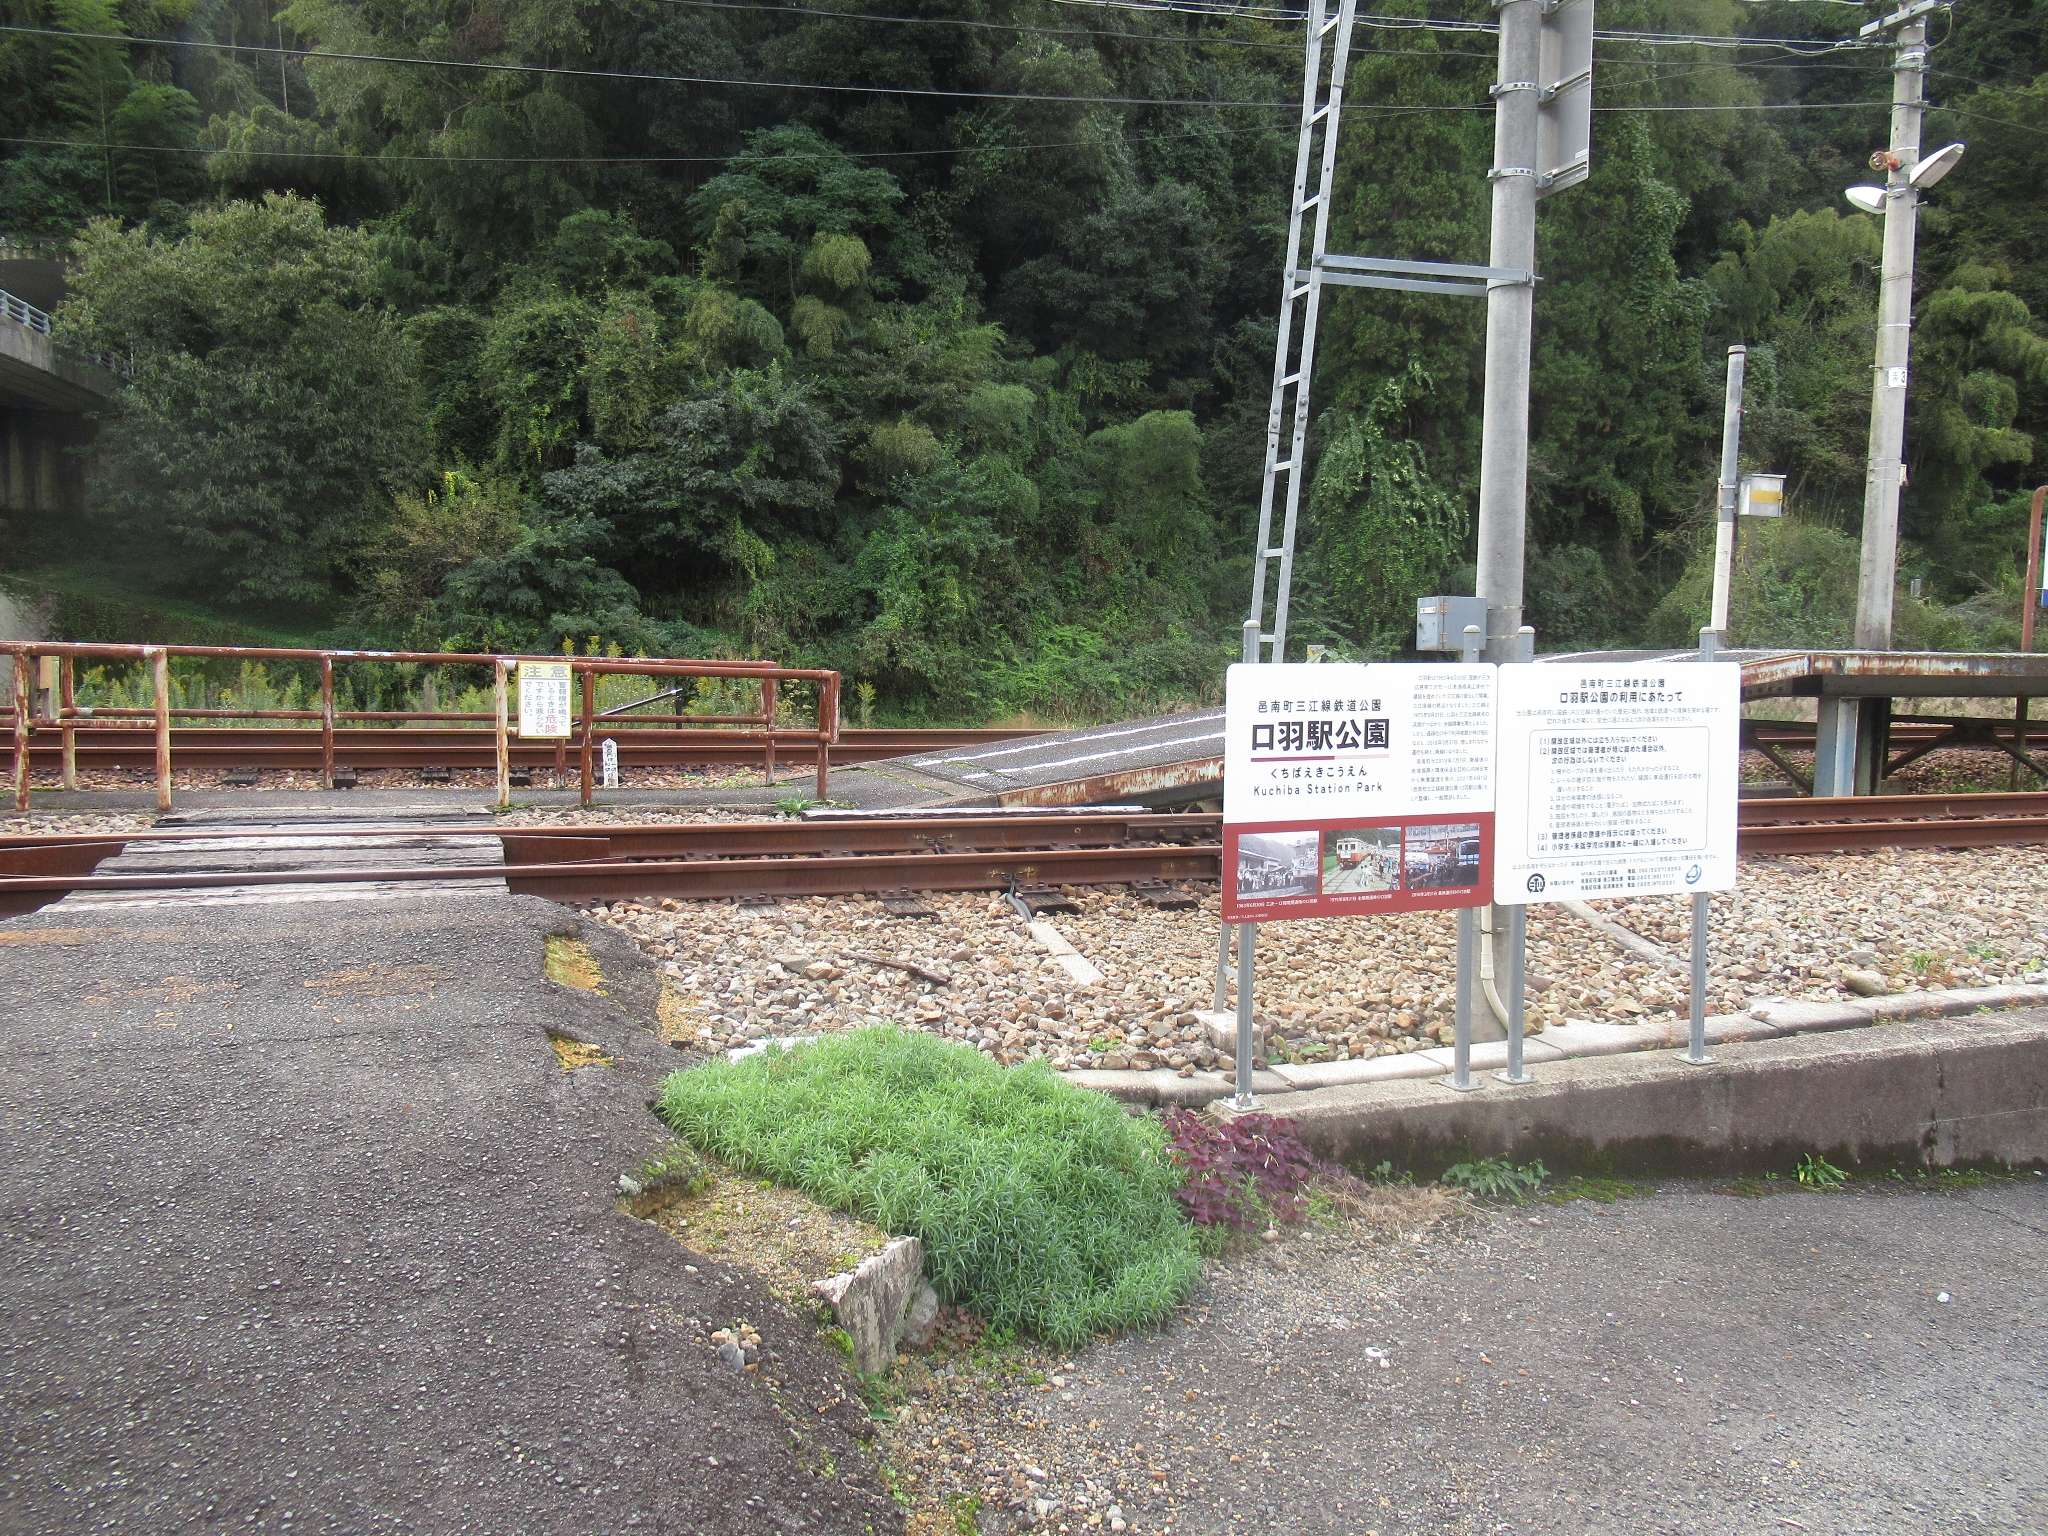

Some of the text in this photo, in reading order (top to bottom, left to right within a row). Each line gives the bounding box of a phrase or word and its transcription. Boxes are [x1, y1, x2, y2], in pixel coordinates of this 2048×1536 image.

[524, 665, 567, 678] 注意
[1560, 691, 1683, 704] 口羽駅公園の利用にあたって
[1258, 698, 1382, 713] 邑南町三江線鉄道公園
[1250, 718, 1390, 752] 口羽駅公園
[1271, 765, 1368, 779] くちばえきこうえん
[1253, 782, 1383, 796] Kuchiba Station Park
